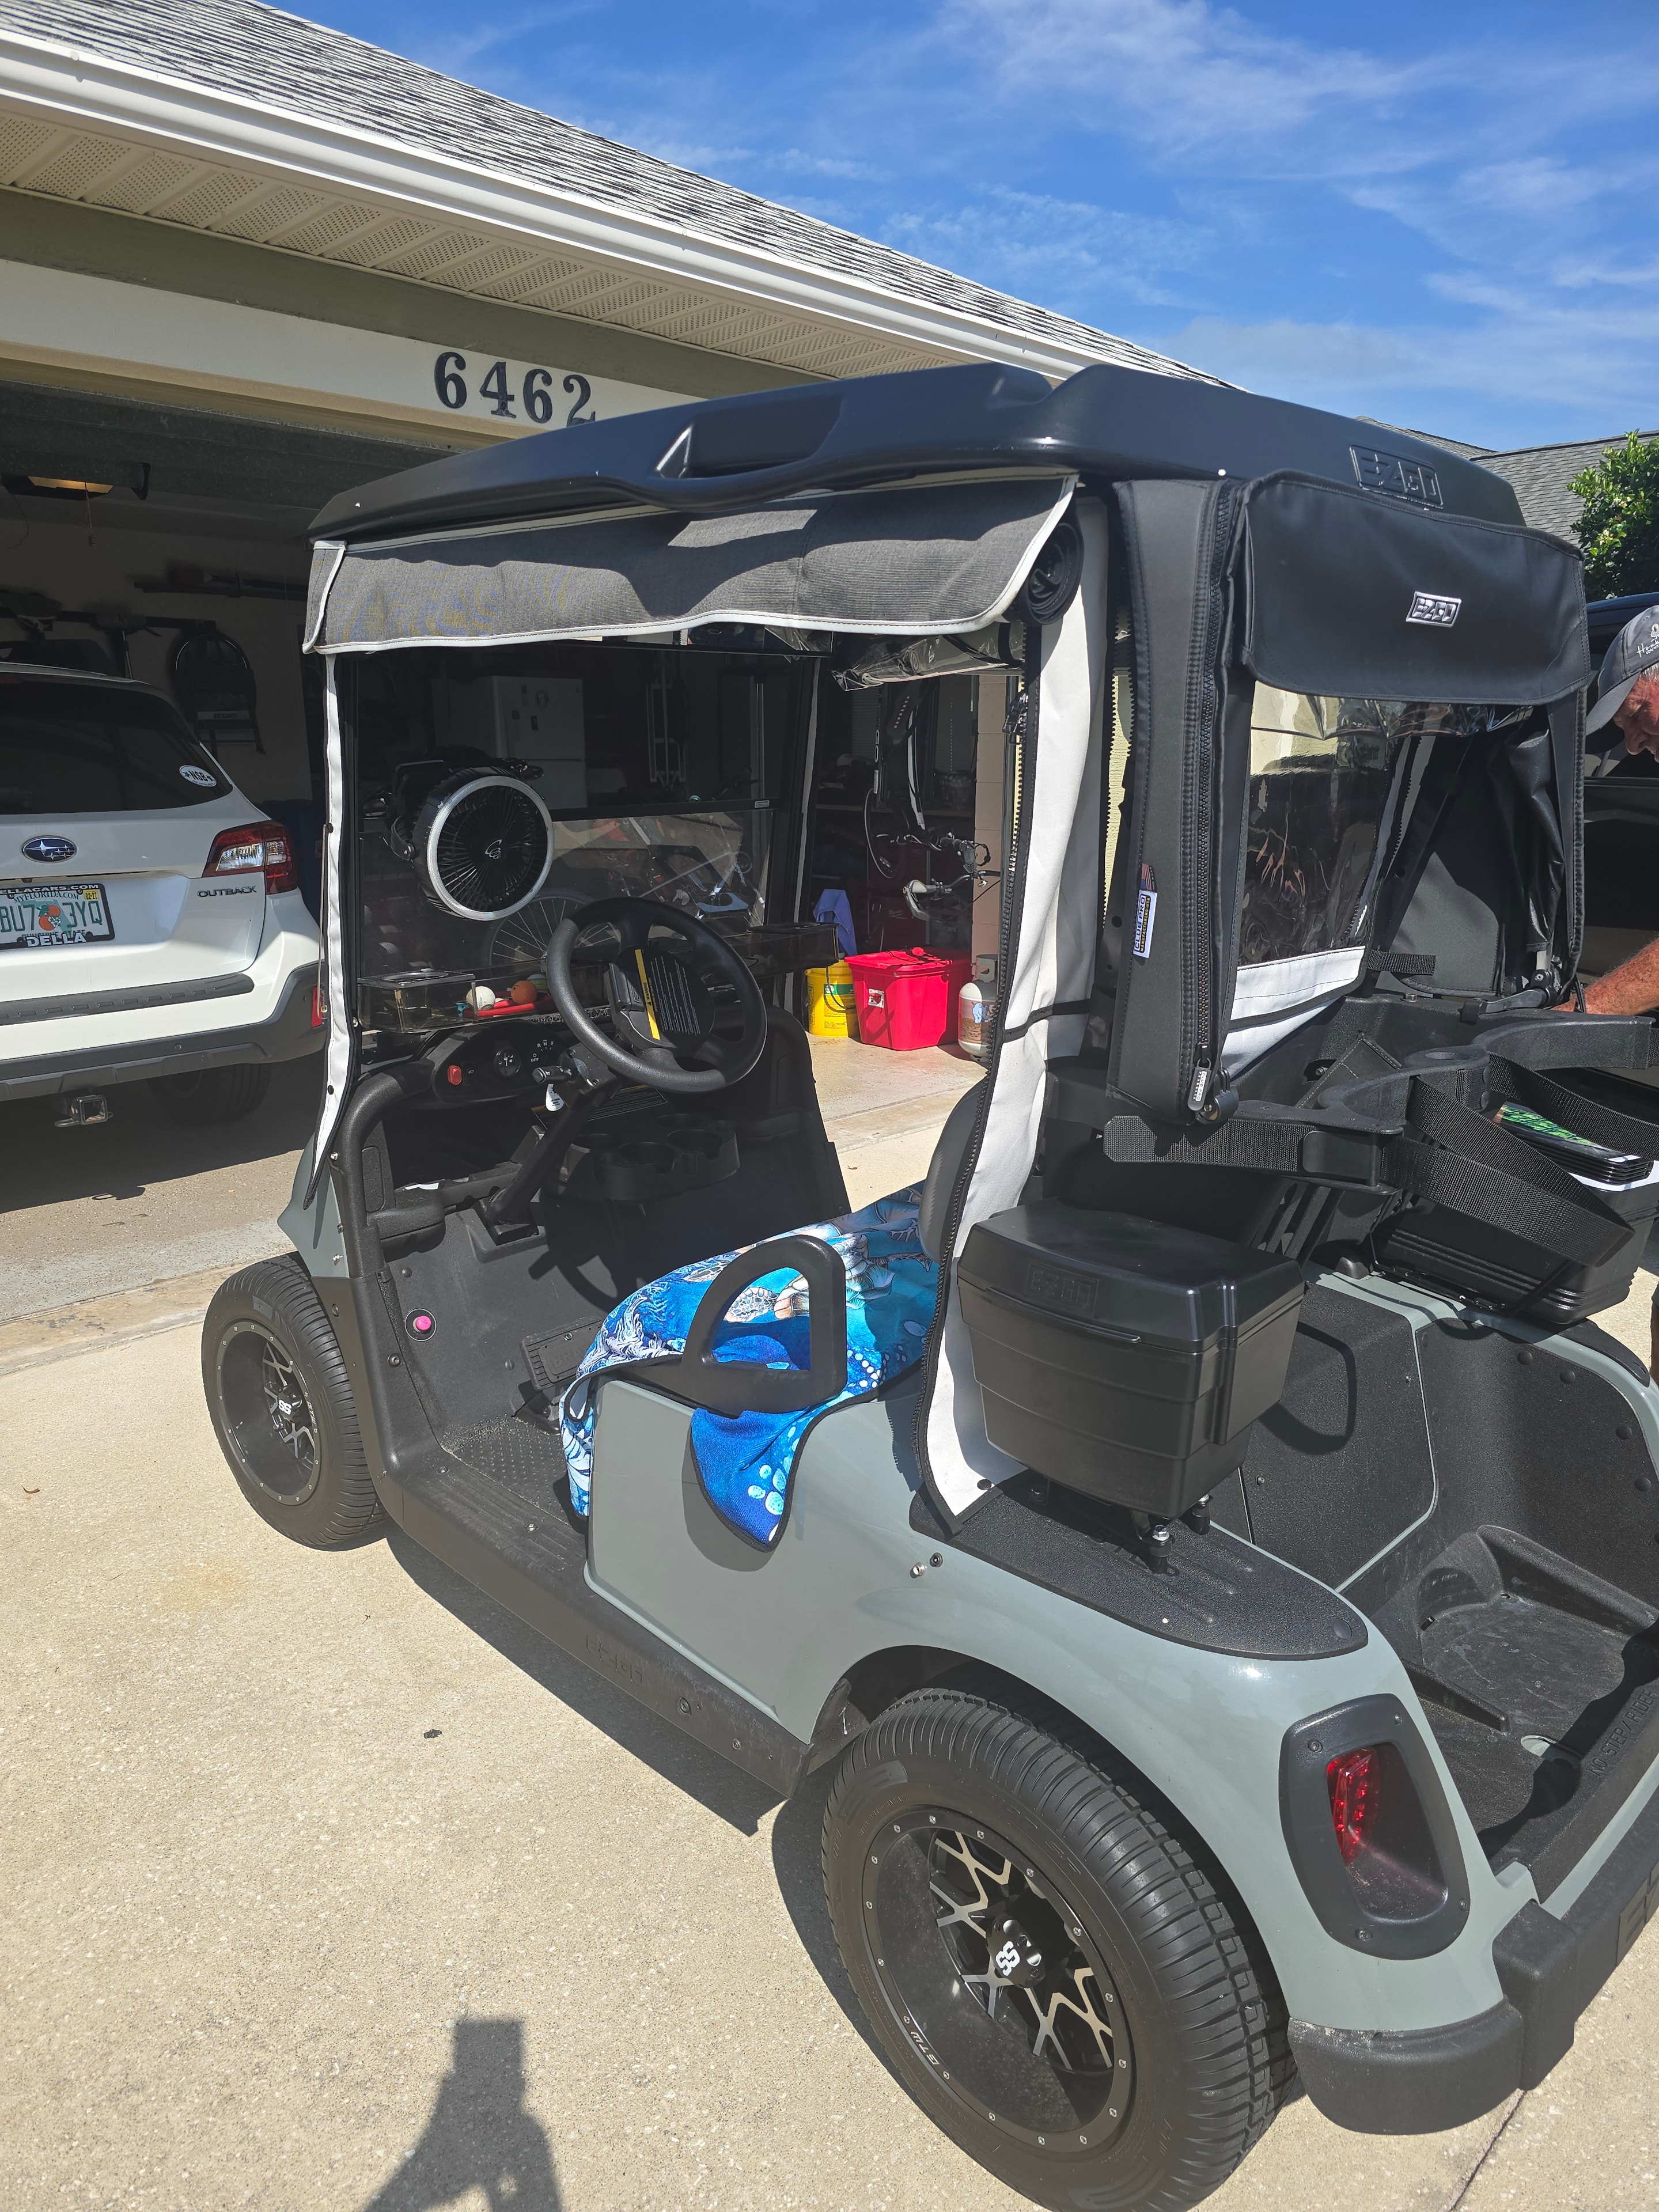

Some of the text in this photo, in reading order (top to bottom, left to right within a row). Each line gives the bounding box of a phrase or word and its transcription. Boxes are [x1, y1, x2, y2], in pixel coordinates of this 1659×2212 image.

[434, 351, 596, 427] 6462
[198, 886, 257, 897] OUTBACK
[62, 901, 103, 928] 3YQ
[26, 933, 86, 947] DELLA
